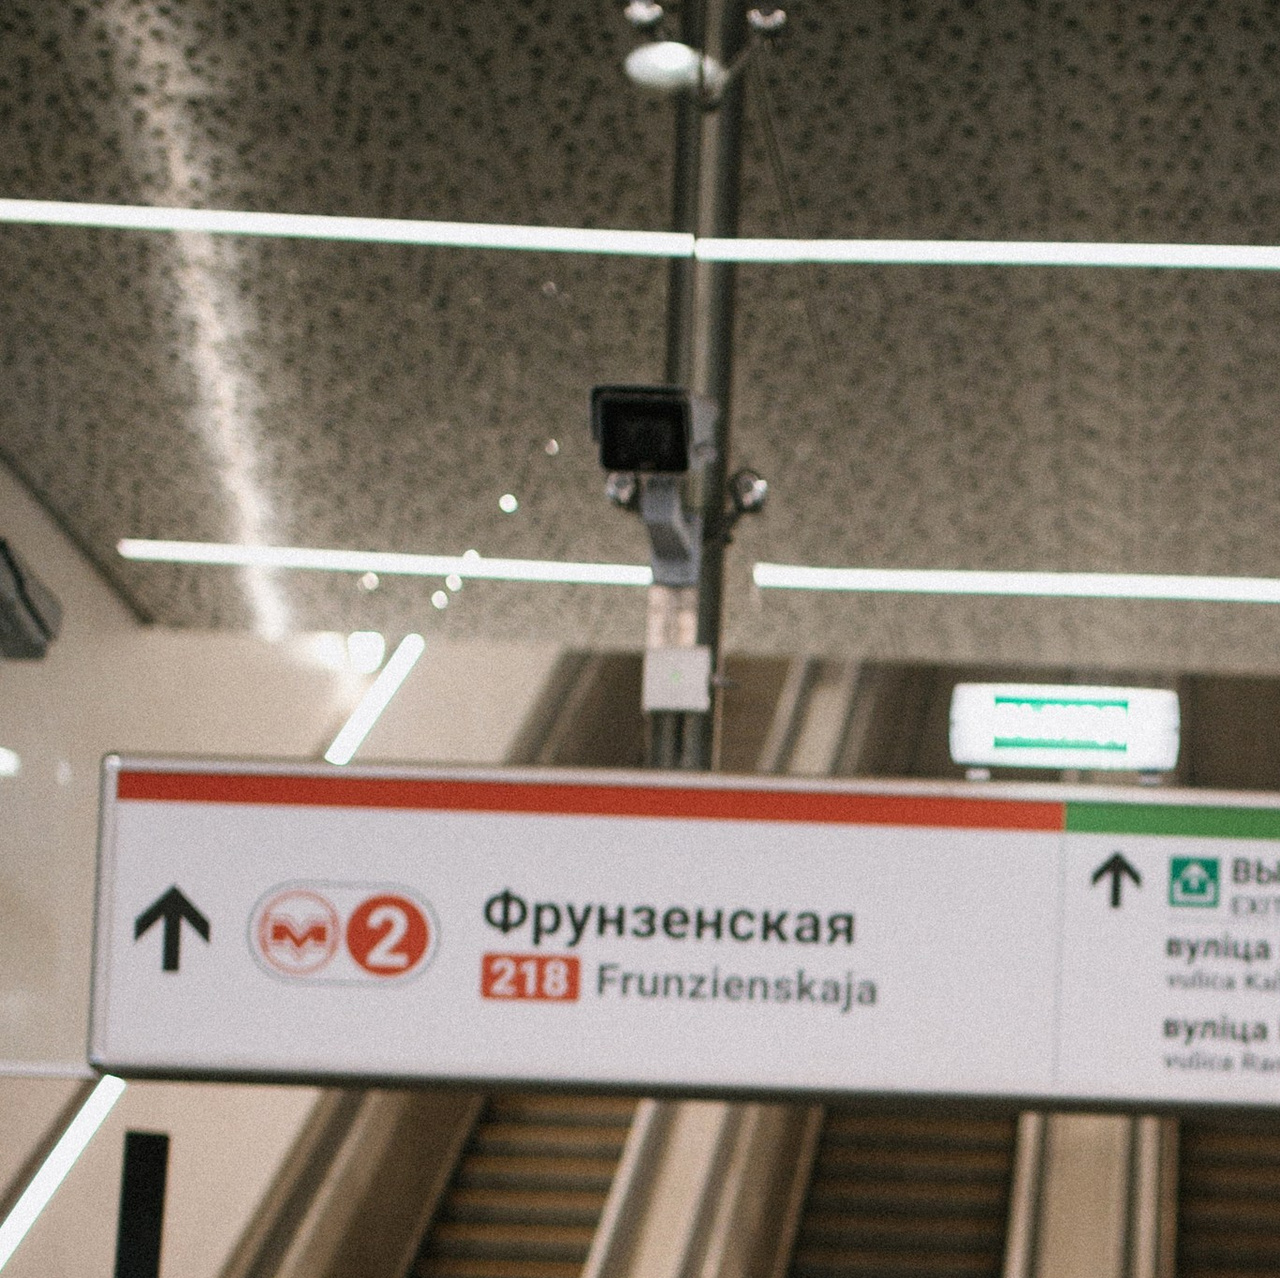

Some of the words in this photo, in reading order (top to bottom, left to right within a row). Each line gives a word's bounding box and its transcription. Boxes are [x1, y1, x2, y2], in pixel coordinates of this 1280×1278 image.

[366, 902, 409, 970] 2
[483, 889, 855, 947] Фрунзенская
[1165, 933, 1271, 964] вуліца
[488, 958, 570, 998] 218
[597, 963, 878, 1013] Frunzienskaja
[1163, 1014, 1269, 1045] вуліца
